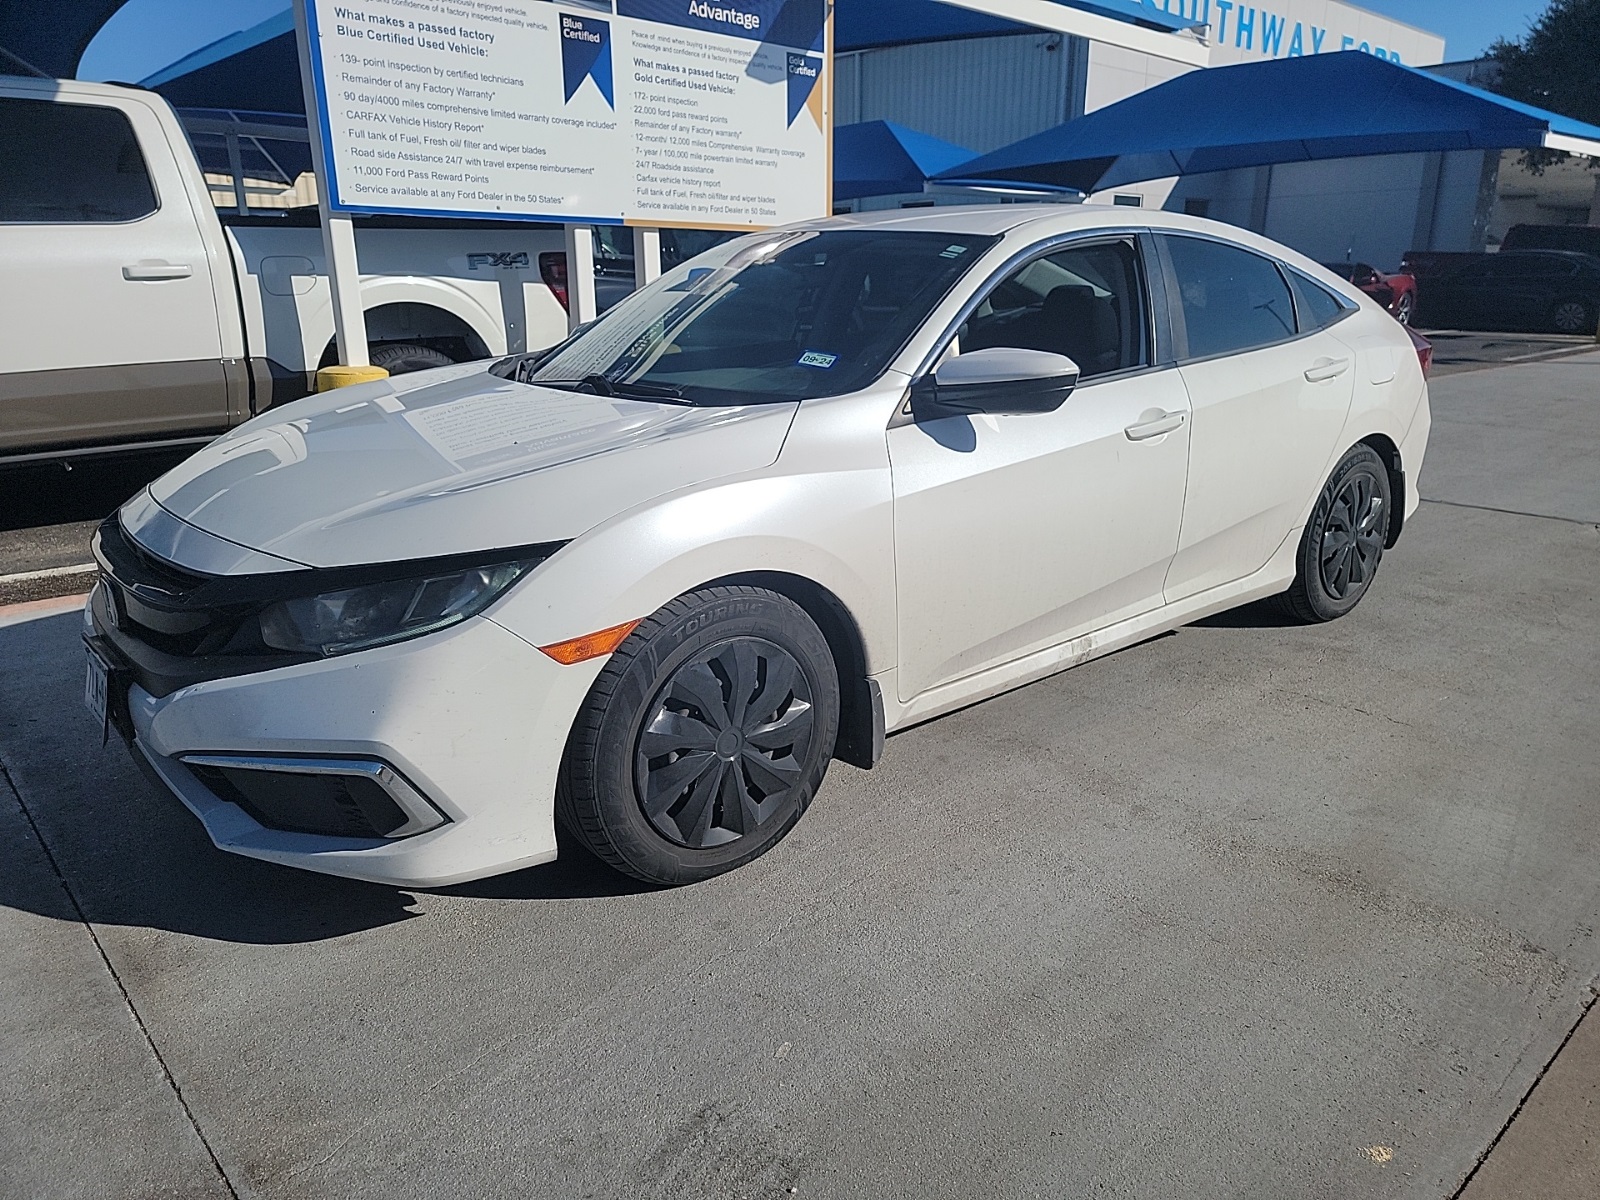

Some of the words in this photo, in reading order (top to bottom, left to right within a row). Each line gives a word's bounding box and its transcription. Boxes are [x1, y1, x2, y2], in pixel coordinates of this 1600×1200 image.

[477, 2, 502, 12] enjoyed
[688, 0, 760, 30] Advantage
[334, 6, 365, 21] What
[368, 14, 405, 28] makes
[418, 22, 456, 36] passed
[459, 26, 494, 44] factory
[447, 7, 469, 18] factory
[471, 12, 502, 24] inspected
[504, 17, 524, 28] quality
[562, 17, 582, 30] Blue
[337, 24, 363, 39] Blue
[367, 29, 414, 46] Certified
[418, 37, 444, 50] Used
[448, 42, 488, 57] Vehicle:
[563, 28, 600, 43] Certified
[631, 30, 648, 39] Peace
[708, 44, 732, 54] previously
[632, 41, 661, 52] Knowledge
[673, 48, 700, 58] confidence
[340, 53, 360, 63] 139-
[363, 58, 385, 68] point
[388, 59, 431, 74] inspection
[434, 66, 444, 78] by
[446, 69, 478, 81] certified
[480, 73, 524, 87] technicians
[633, 57, 654, 68] What
[656, 62, 680, 72] makes
[688, 67, 714, 78] passed
[715, 70, 739, 83] factory
[789, 56, 804, 66] Gold
[789, 65, 816, 77] Certified
[341, 72, 392, 87] Remainder
[394, 80, 402, 88] of
[405, 82, 421, 92] any
[423, 82, 454, 97] Factory
[634, 73, 653, 83] Gold
[655, 76, 686, 88] Certified
[688, 81, 706, 90] Used
[708, 84, 735, 94] Vehicle:
[344, 91, 356, 101] 90
[358, 93, 400, 106] day/4000
[402, 100, 424, 109] miles
[427, 103, 488, 116] comprehensive
[491, 108, 516, 119] limited
[517, 113, 549, 124] warranty
[551, 117, 584, 128] coverage
[667, 96, 698, 106] inspection
[346, 110, 387, 123] CARFAX
[389, 115, 420, 126] Vehicle
[423, 119, 452, 131] History
[657, 108, 670, 117] ford
[688, 113, 708, 121] reward
[634, 119, 669, 129] Remainder
[679, 126, 690, 134] any
[692, 126, 713, 136] Factory
[348, 128, 365, 139] Full
[368, 131, 387, 141] tank
[389, 133, 398, 141] of
[400, 134, 421, 144] Fuel,
[424, 136, 447, 146] Fresh
[463, 140, 481, 149] filter
[500, 144, 520, 153] wiper
[522, 146, 546, 155] blades
[708, 141, 753, 152] Comprehensive
[756, 146, 780, 156] Warranty
[781, 149, 805, 158] coverage
[350, 147, 375, 157] Road
[377, 150, 395, 159] side
[398, 151, 443, 163] Assistance
[445, 155, 462, 164] 24/7
[465, 158, 481, 166] with
[483, 159, 505, 168] travel
[507, 162, 538, 171] expense
[636, 160, 650, 168] 24/7
[683, 165, 714, 174] assistance
[755, 160, 778, 168] warranty
[353, 166, 383, 176] 11,000
[385, 168, 405, 178] Ford
[408, 170, 428, 179] Pass
[431, 172, 462, 182] Reward
[465, 174, 489, 183] Points
[636, 174, 657, 182] Carfax
[682, 178, 701, 187] history
[355, 184, 388, 193] Service
[391, 187, 428, 196] available
[441, 191, 455, 200] any
[457, 190, 476, 199] Ford
[478, 192, 503, 200] Dealer
[505, 193, 512, 201] in
[514, 194, 526, 202] the
[527, 194, 536, 203] 50
[637, 201, 660, 209] Service
[662, 202, 689, 211] available
[698, 205, 708, 213] any
[466, 252, 530, 270] FX4
[672, 603, 763, 643] TOURING
